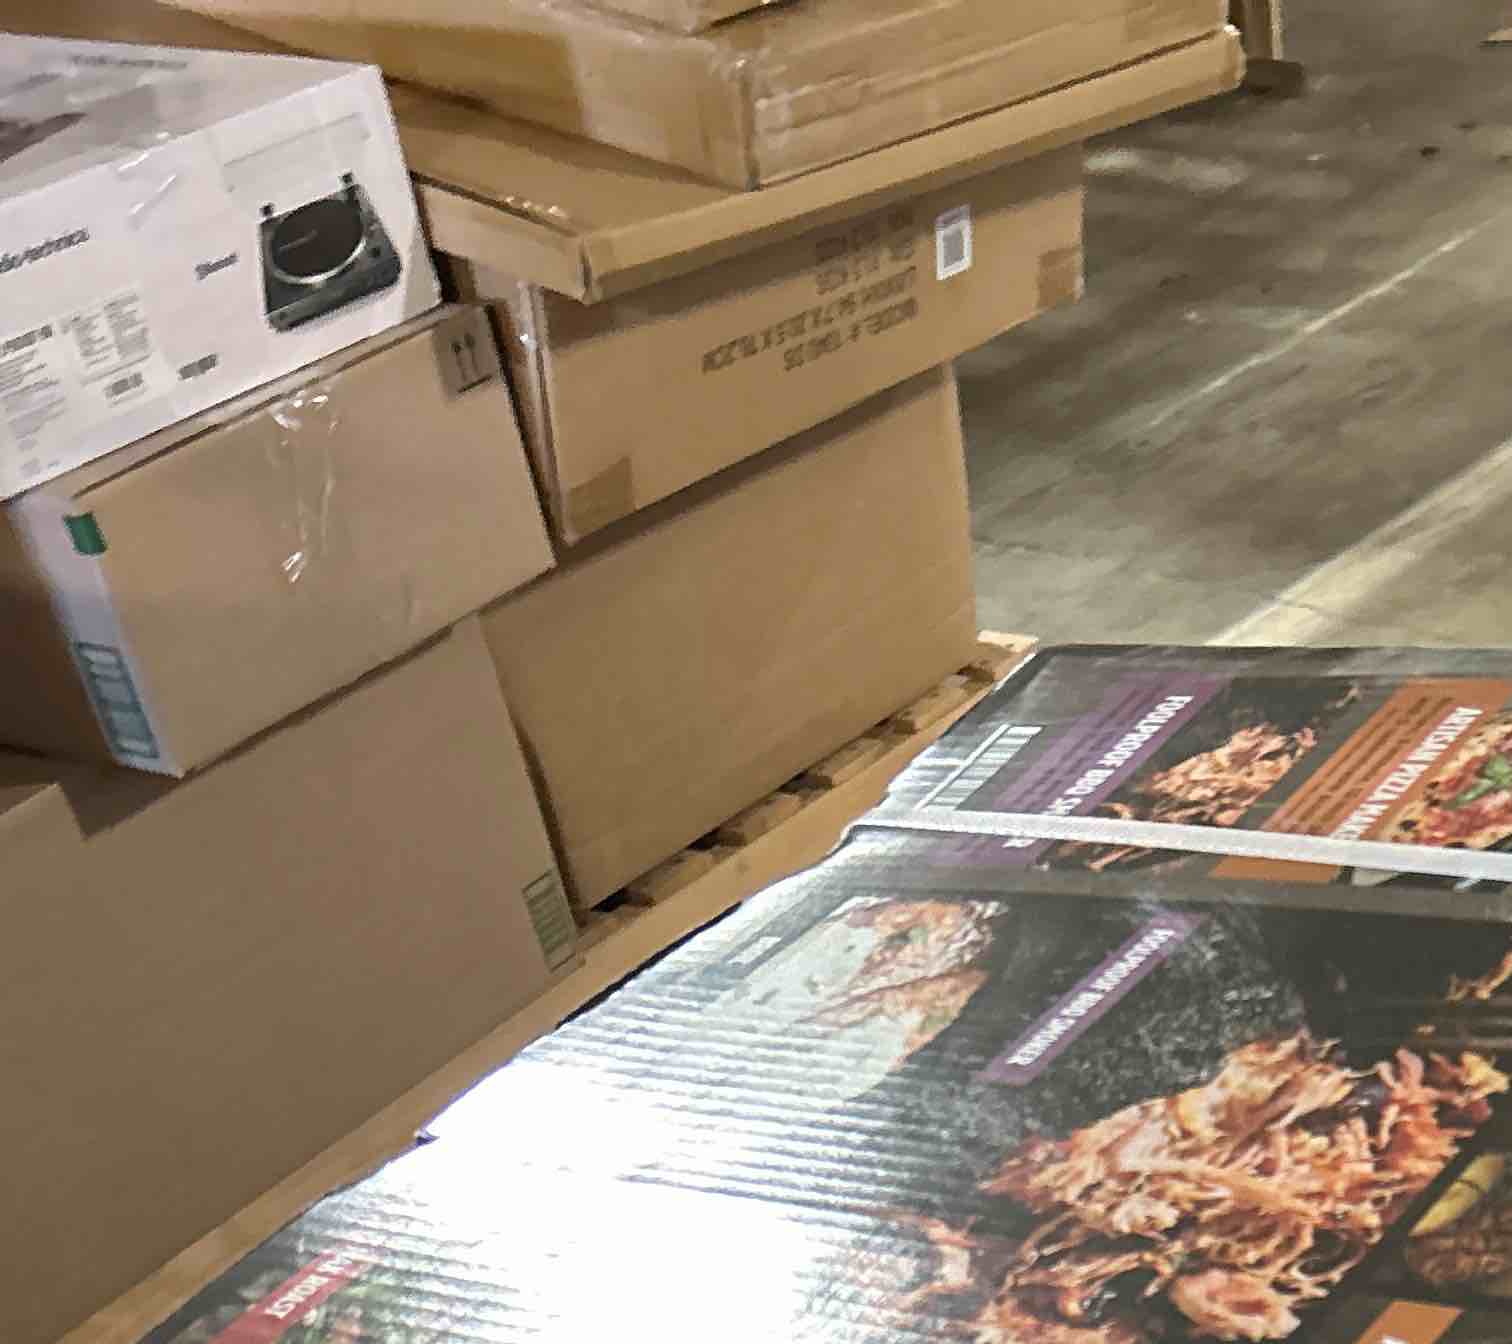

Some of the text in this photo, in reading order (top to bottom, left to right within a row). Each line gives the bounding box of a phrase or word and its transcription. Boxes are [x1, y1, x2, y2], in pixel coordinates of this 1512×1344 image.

[1062, 695, 1196, 795] FOOLPROOF BBQ
[1403, 706, 1488, 761] ARTISAN
[1364, 763, 1431, 802] PIZZA
[1003, 927, 1178, 1066] FOOLPROOF BBQ SMOKER
